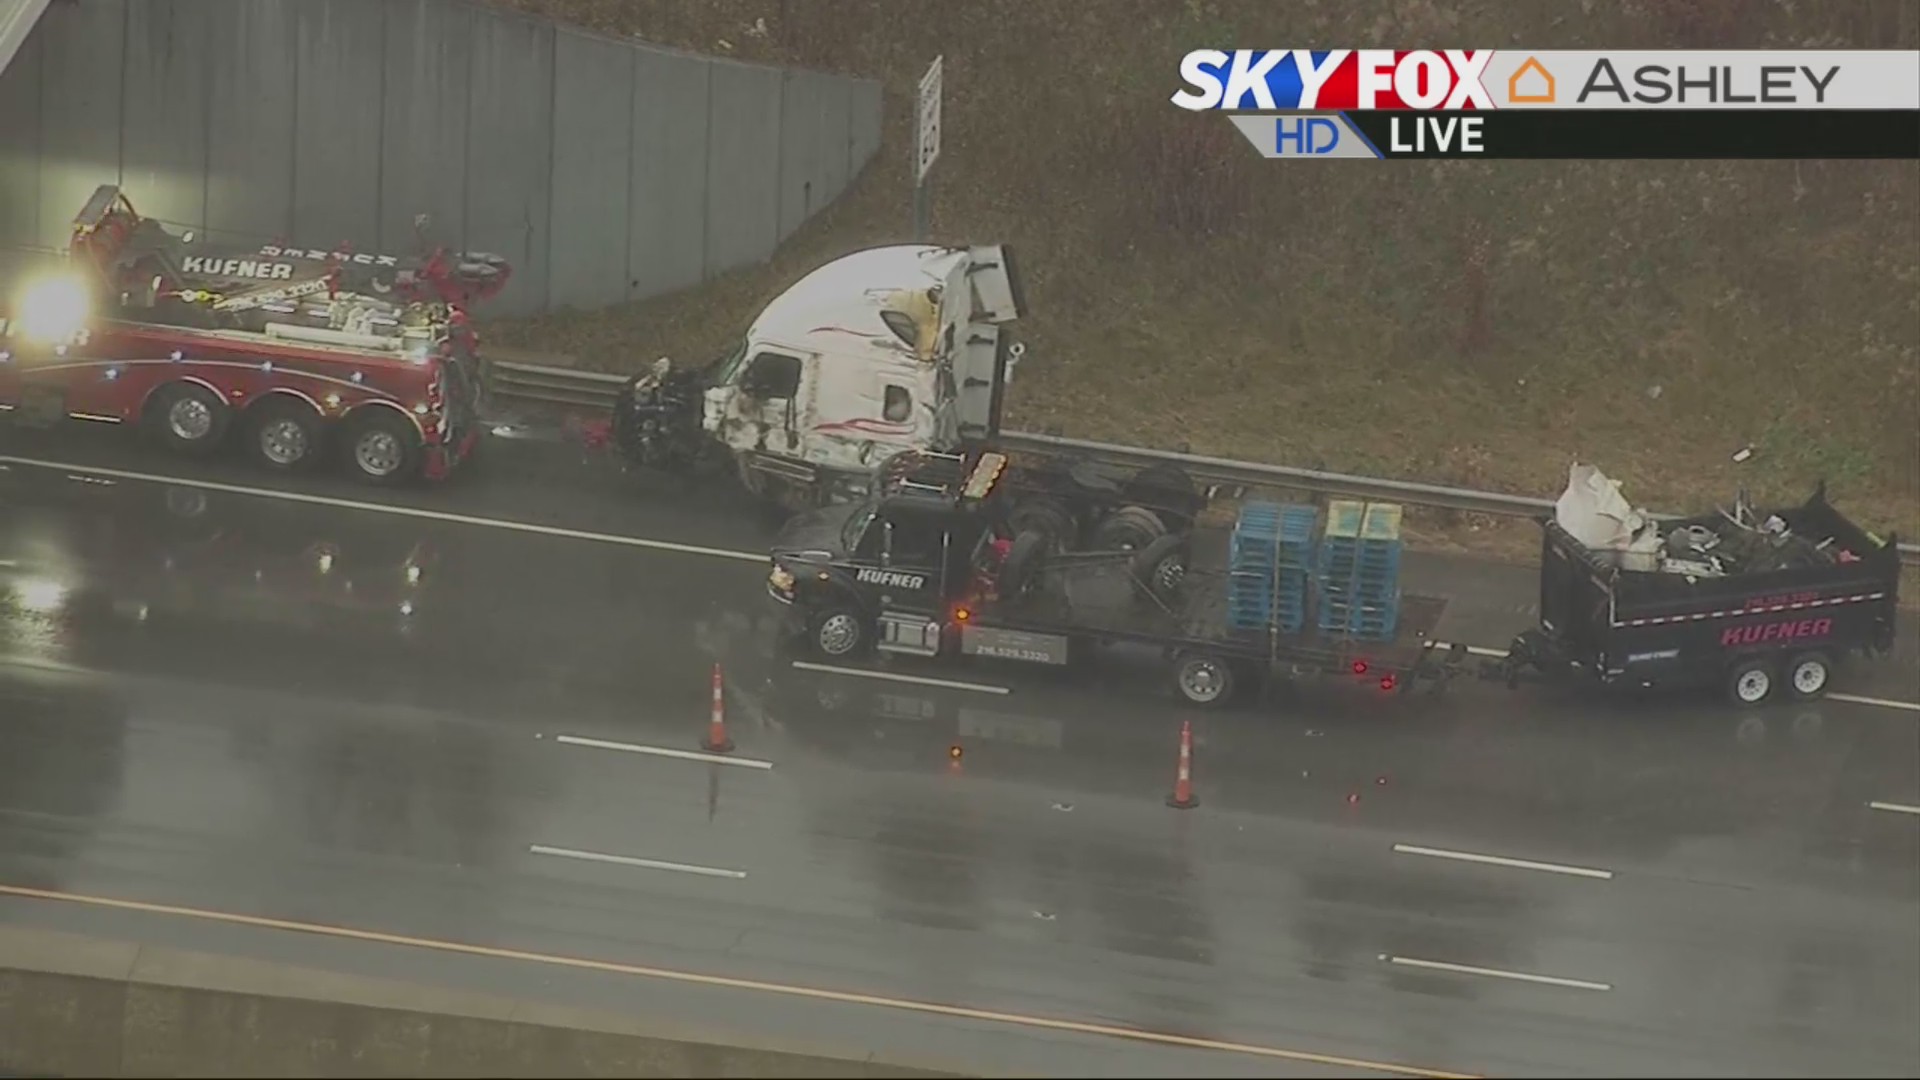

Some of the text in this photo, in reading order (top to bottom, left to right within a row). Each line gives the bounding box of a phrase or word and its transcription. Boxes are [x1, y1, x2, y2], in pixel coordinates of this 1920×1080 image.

[181, 256, 294, 280] KUFNER
[856, 568, 925, 589] KUFNER
[1722, 619, 1831, 646] KUFNER
